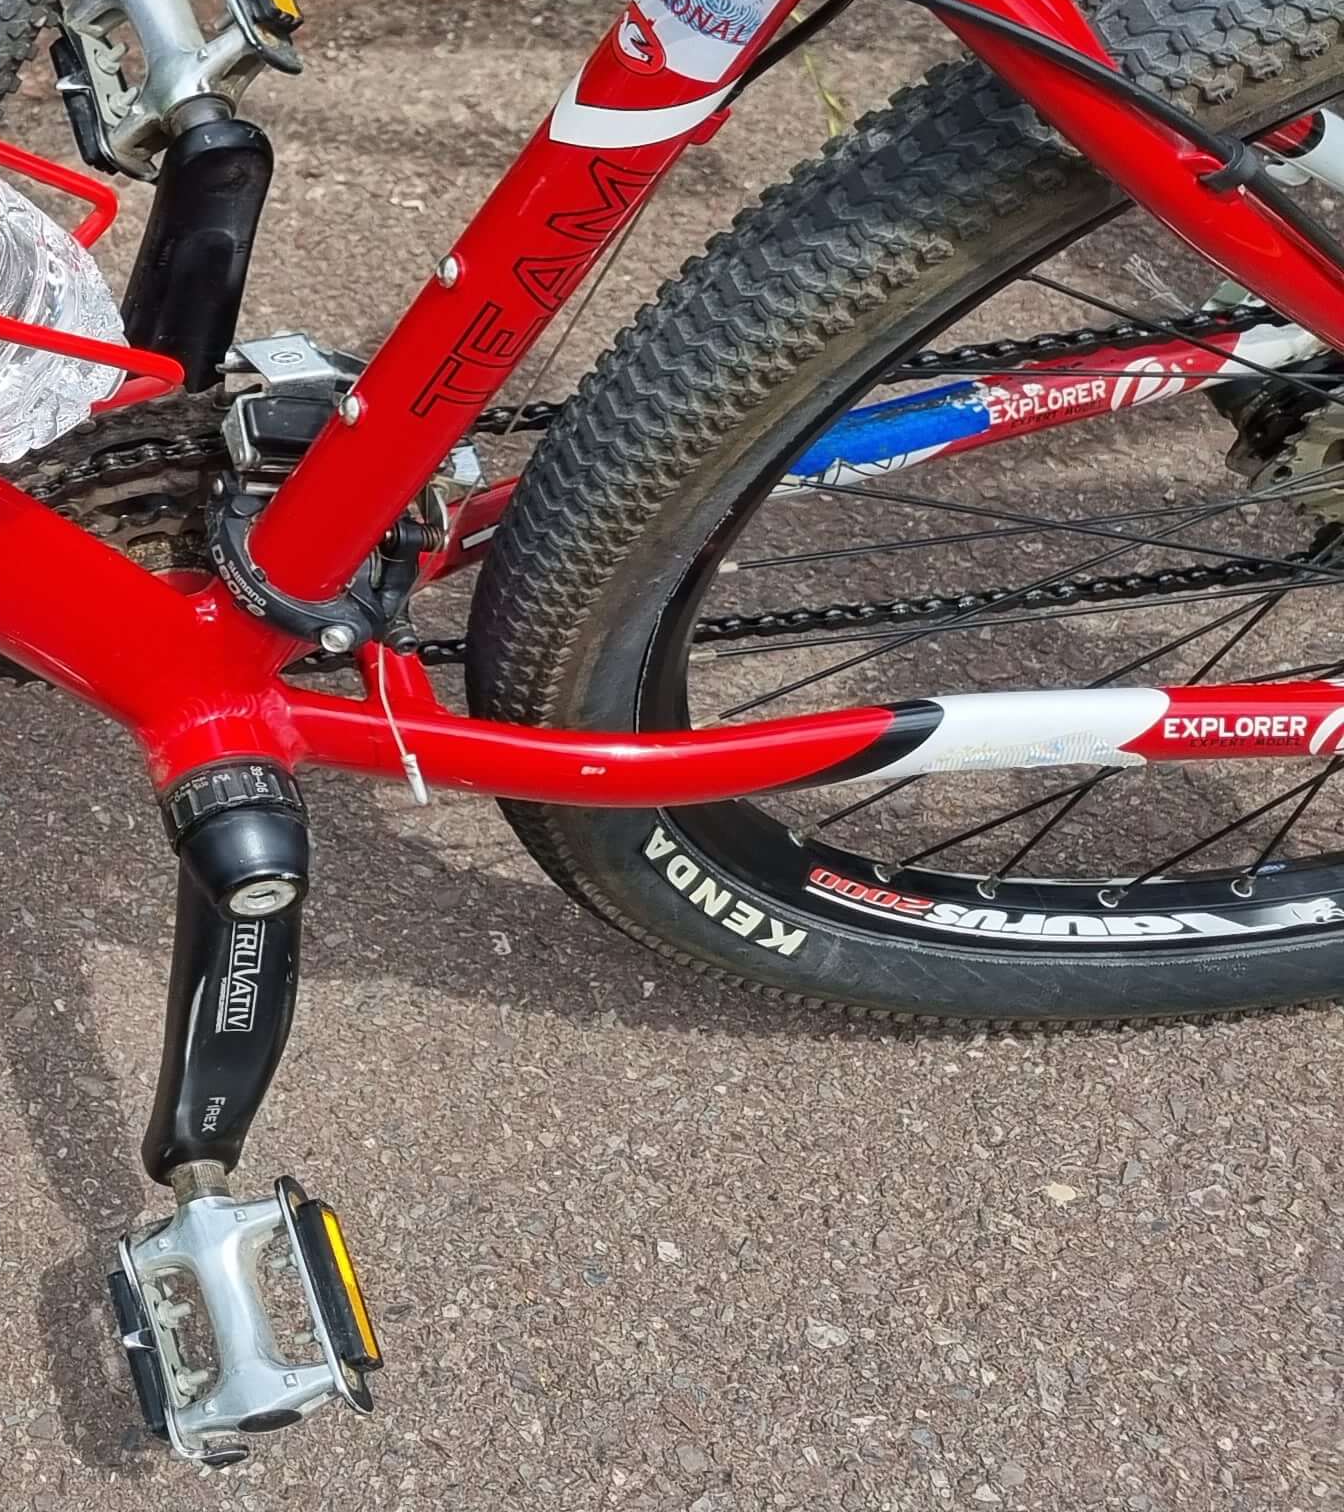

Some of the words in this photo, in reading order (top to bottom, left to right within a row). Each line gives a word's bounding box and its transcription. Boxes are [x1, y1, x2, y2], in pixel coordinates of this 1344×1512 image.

[412, 156, 660, 418] TEAM
[989, 379, 1107, 426] EXPLORER
[1163, 715, 1308, 740] EXPLORER
[640, 826, 809, 958] KENDA
[811, 867, 933, 916] 2000
[226, 919, 260, 1030] TRUVATIV
